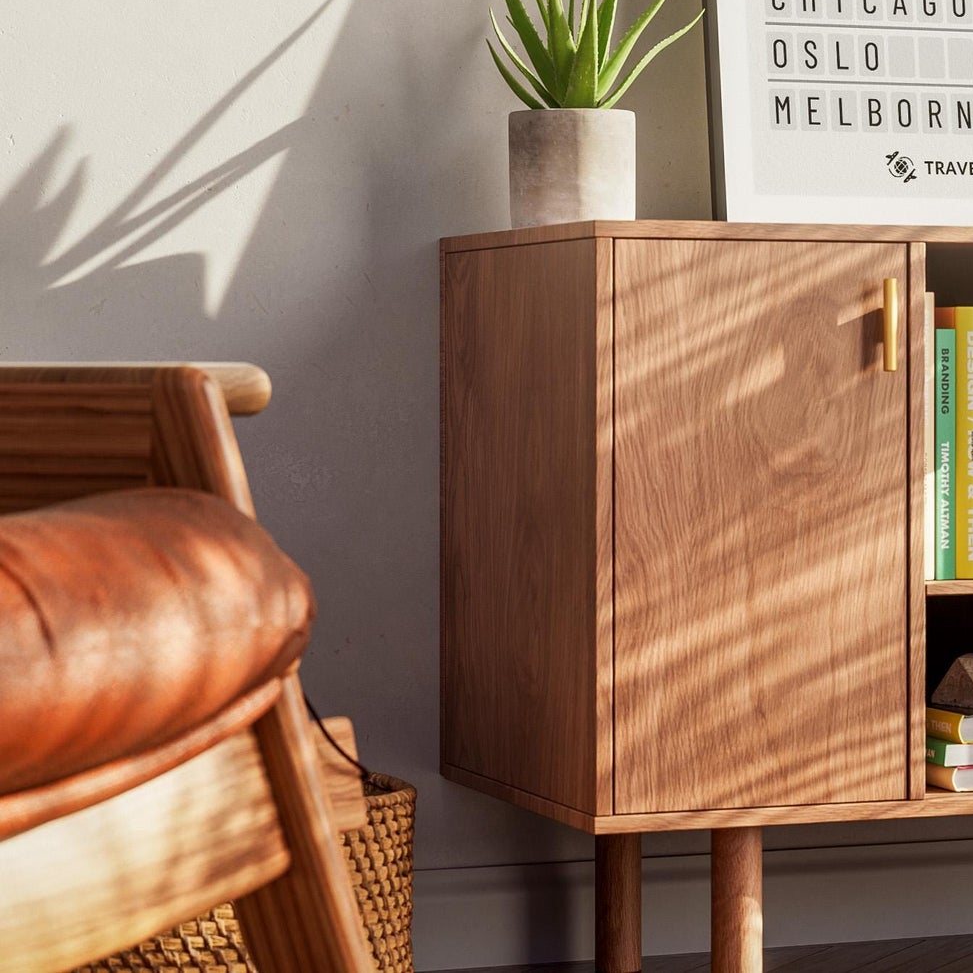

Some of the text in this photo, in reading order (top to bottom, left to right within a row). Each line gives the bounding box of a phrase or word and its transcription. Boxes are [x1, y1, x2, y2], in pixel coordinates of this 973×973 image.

[773, 39, 879, 72] OSLO
[941, 348, 949, 415] BRANDING
[941, 442, 949, 549] TIMOTHY ALTMAN
